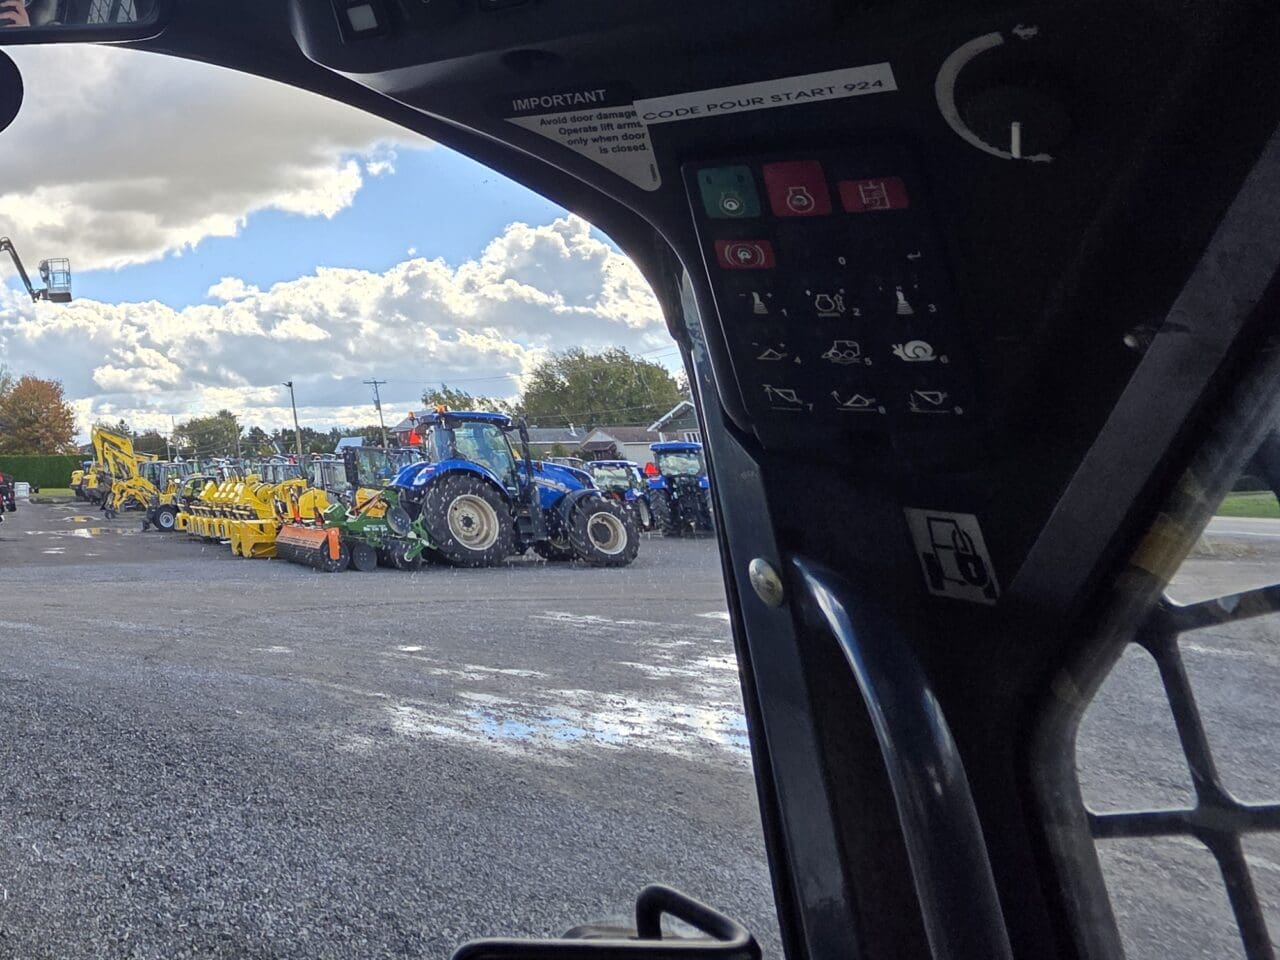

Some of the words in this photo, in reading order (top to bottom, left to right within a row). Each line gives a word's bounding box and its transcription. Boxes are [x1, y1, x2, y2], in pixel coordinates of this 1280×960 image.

[512, 89, 606, 111] IMPORTANT
[643, 105, 700, 120] CODE
[707, 96, 765, 112] POUR
[770, 86, 836, 103] START
[844, 79, 885, 92] 924
[540, 116, 567, 126] Avoid
[570, 113, 593, 123] door
[596, 110, 637, 120] damage
[558, 126, 598, 137] Operate
[600, 123, 615, 132] lift
[567, 136, 589, 146] only
[591, 134, 619, 144] when
[621, 131, 646, 141] door
[599, 146, 609, 154] is
[611, 143, 649, 153] closed.
